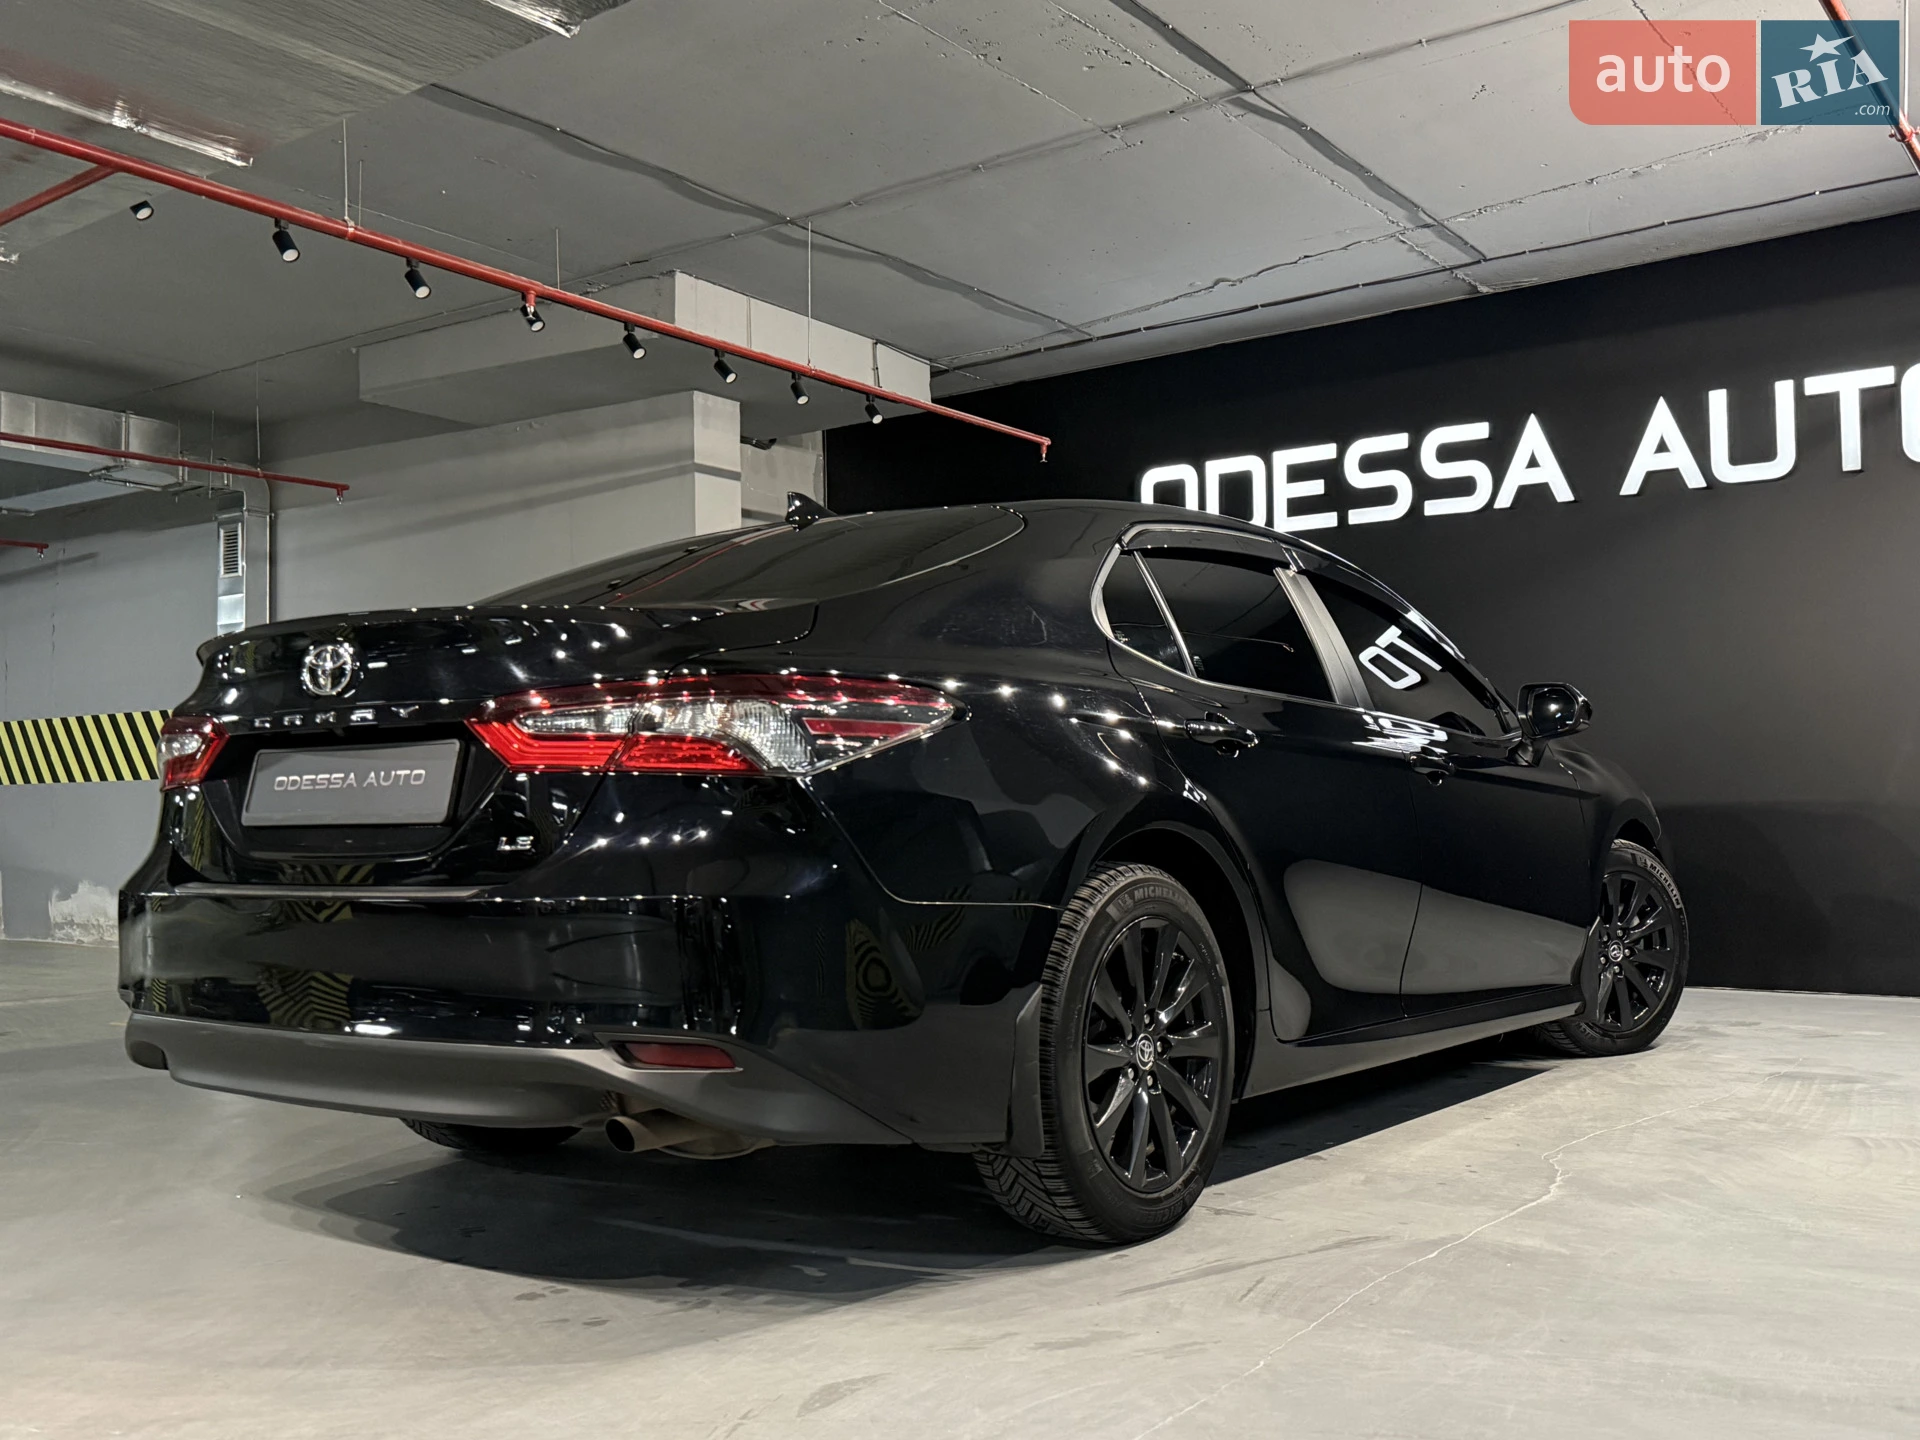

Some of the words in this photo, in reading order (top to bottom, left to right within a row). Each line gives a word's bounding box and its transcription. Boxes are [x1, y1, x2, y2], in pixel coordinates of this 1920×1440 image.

[1618, 362, 1920, 498] AUT
[274, 772, 357, 792] ODESSA
[363, 769, 427, 787] AUTO
[497, 835, 535, 851] LE
[1650, 863, 1682, 906] MICHELIN
